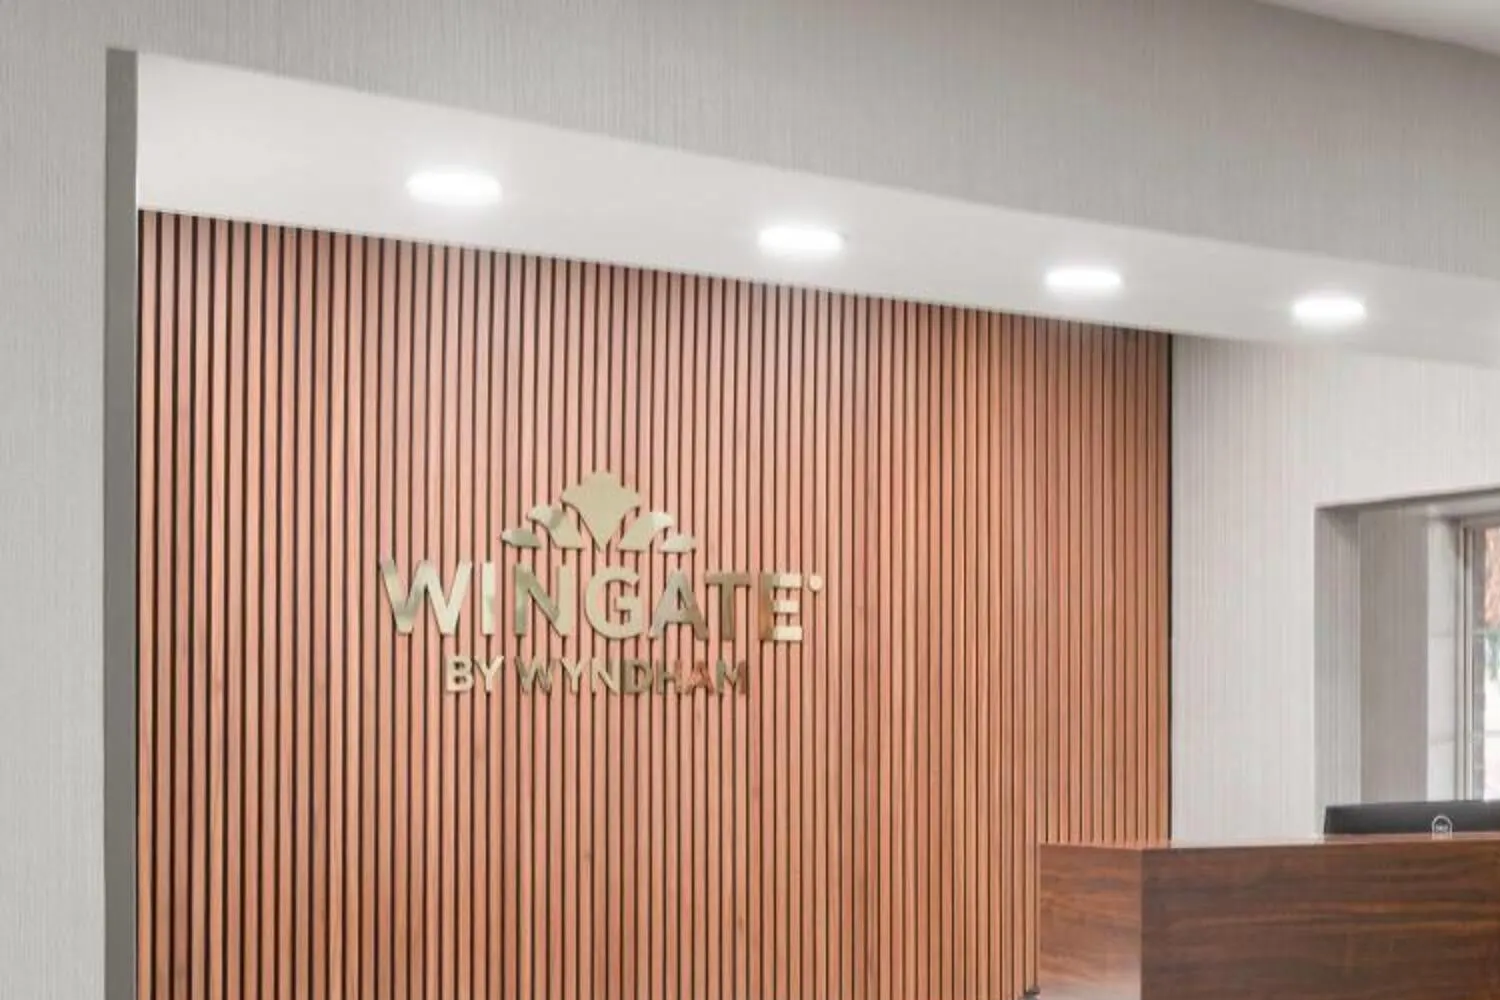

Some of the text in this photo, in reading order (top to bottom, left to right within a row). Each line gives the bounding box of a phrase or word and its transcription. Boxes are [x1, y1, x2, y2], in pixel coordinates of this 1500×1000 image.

[379, 559, 803, 641] WINGATE
[446, 655, 748, 696] BY WYNDHAM
